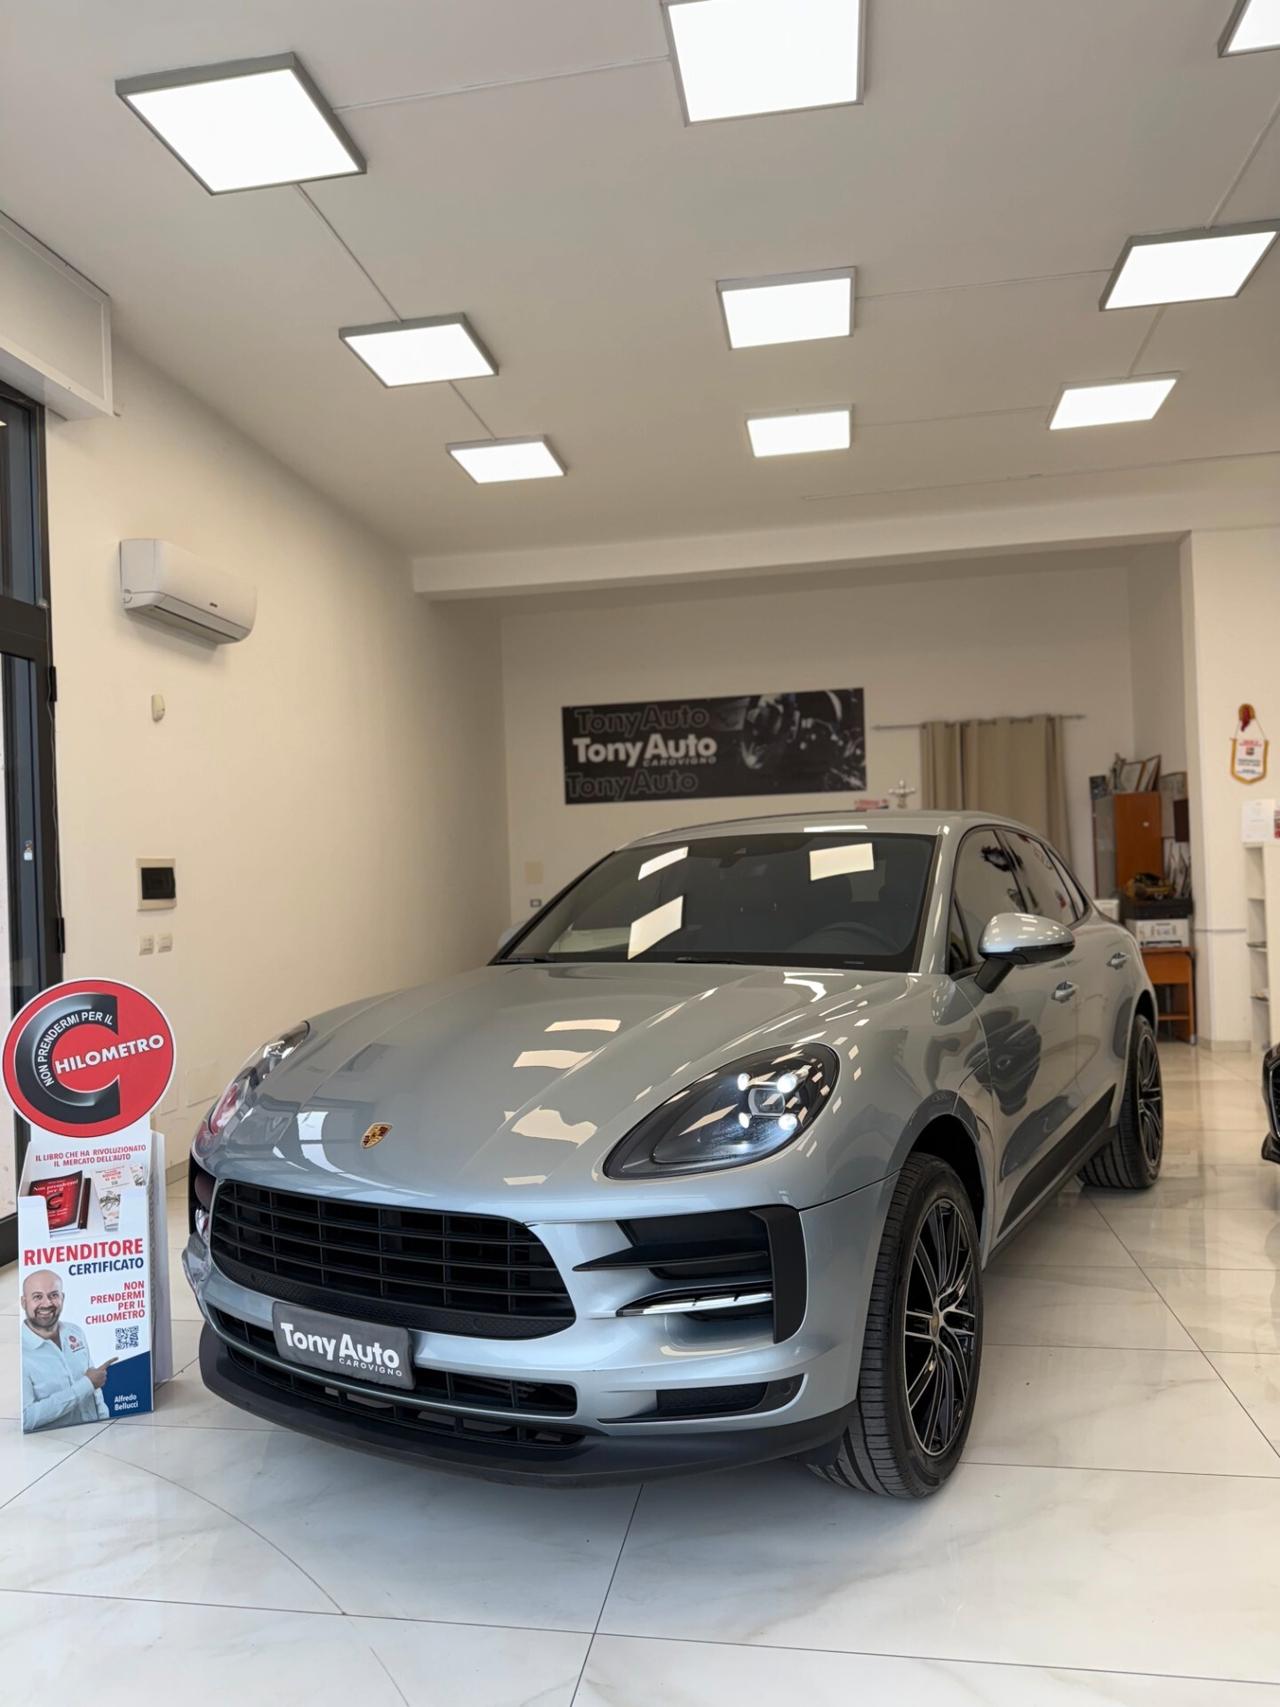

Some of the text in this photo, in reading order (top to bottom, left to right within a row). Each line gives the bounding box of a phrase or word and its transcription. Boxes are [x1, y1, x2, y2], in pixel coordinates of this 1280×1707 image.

[642, 755, 717, 768] CAROVIGNO
[37, 1011, 113, 1087] NON PRENDERMI PER IL
[35, 1144, 147, 1162] IL LIBRO CHE HA RIVOLUZIONATO
[54, 1153, 132, 1168] IL MERCATO DELL'AUTO
[24, 1238, 144, 1266] RIVENDITORE
[68, 1257, 145, 1276] CERTIFICATO
[124, 1280, 145, 1291] NON
[90, 1290, 145, 1305] PRENDERMI
[118, 1300, 146, 1311] PER IL
[85, 1309, 146, 1326] CHILOMETRO
[338, 1358, 403, 1377] CAROVIGNO
[114, 1393, 137, 1403] Alfredo
[114, 1401, 139, 1412] Bellucci
